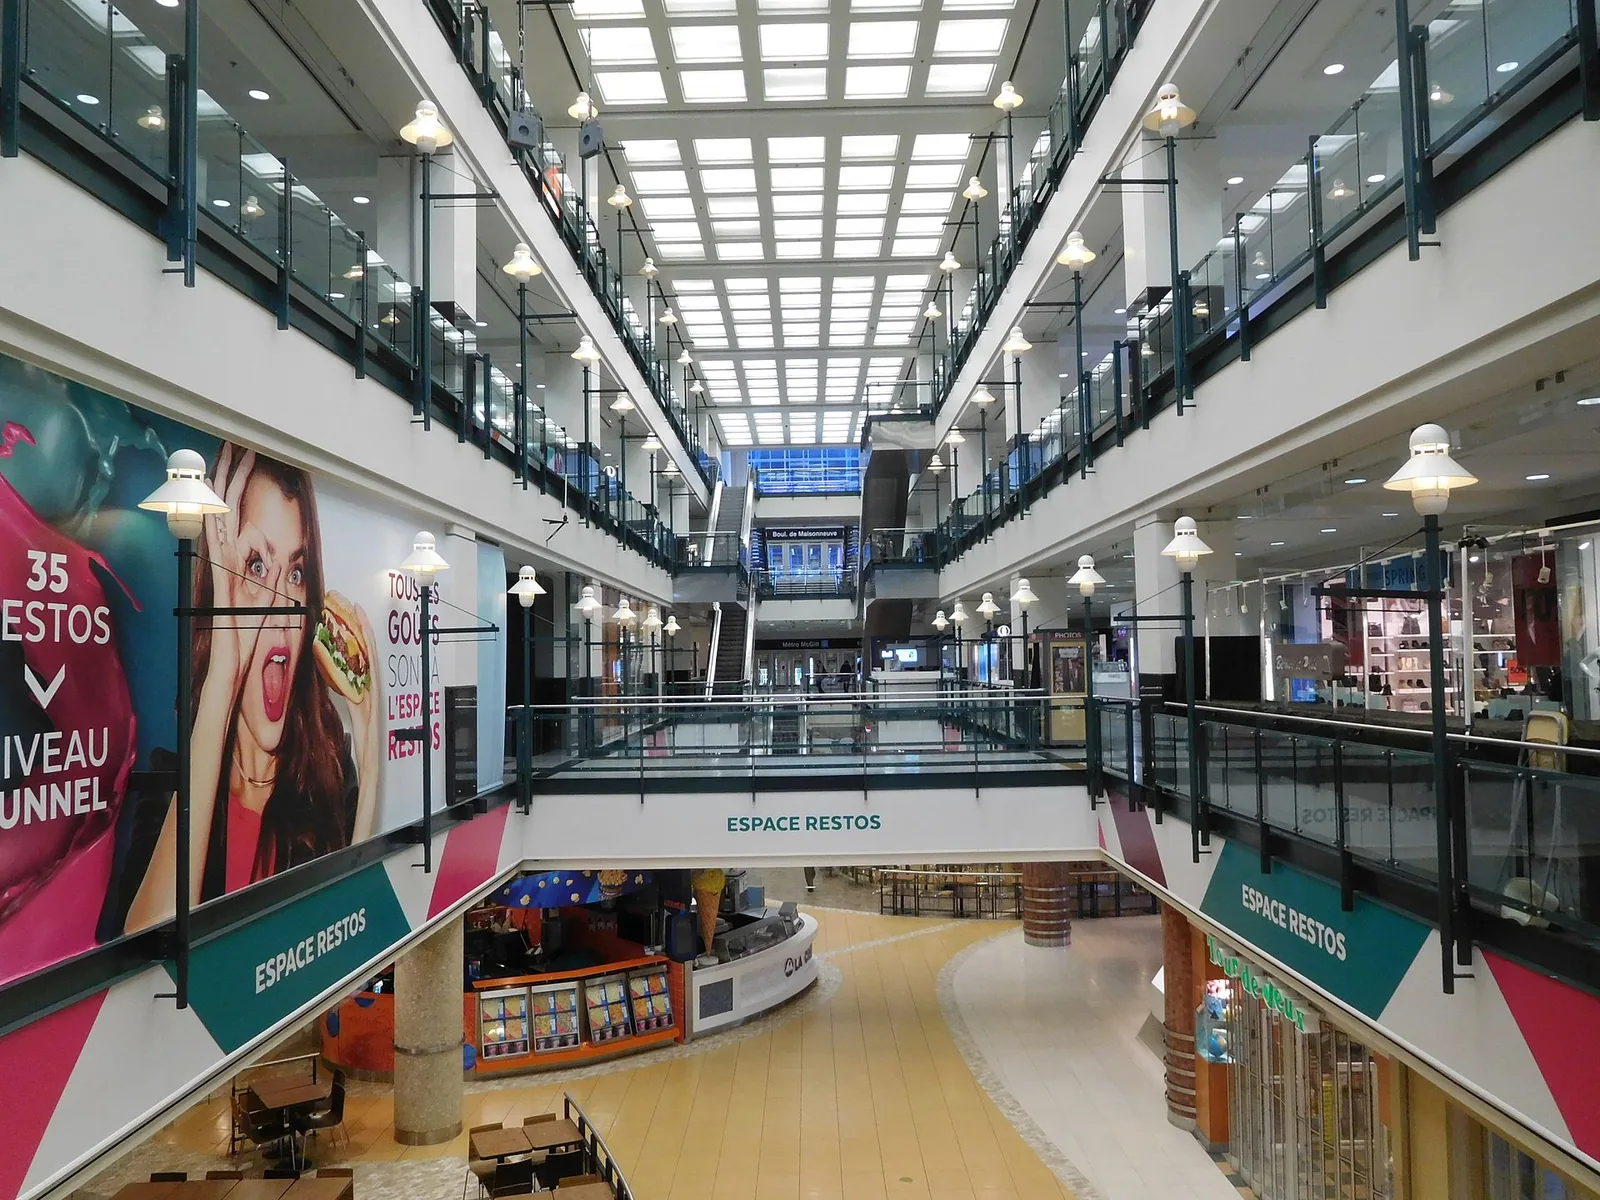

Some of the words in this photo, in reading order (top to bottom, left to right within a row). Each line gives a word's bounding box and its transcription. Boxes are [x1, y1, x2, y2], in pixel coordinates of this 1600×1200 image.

[26, 549, 69, 593] 35
[388, 572, 419, 602] TOUS
[388, 604, 440, 646] GOÛS
[388, 654, 424, 688] SON
[431, 647, 440, 685] À
[388, 691, 440, 721] L'ESPCE
[388, 721, 441, 761] RESTS
[727, 816, 800, 832] ESPACE
[805, 815, 881, 831] RESTOS
[1241, 883, 1287, 929] ESPACE
[1289, 907, 1347, 961] RESTOS
[255, 936, 315, 994] ESPACE
[317, 907, 366, 958] RESTOS
[1206, 934, 1240, 978] Tour
[1240, 963, 1261, 1000] de
